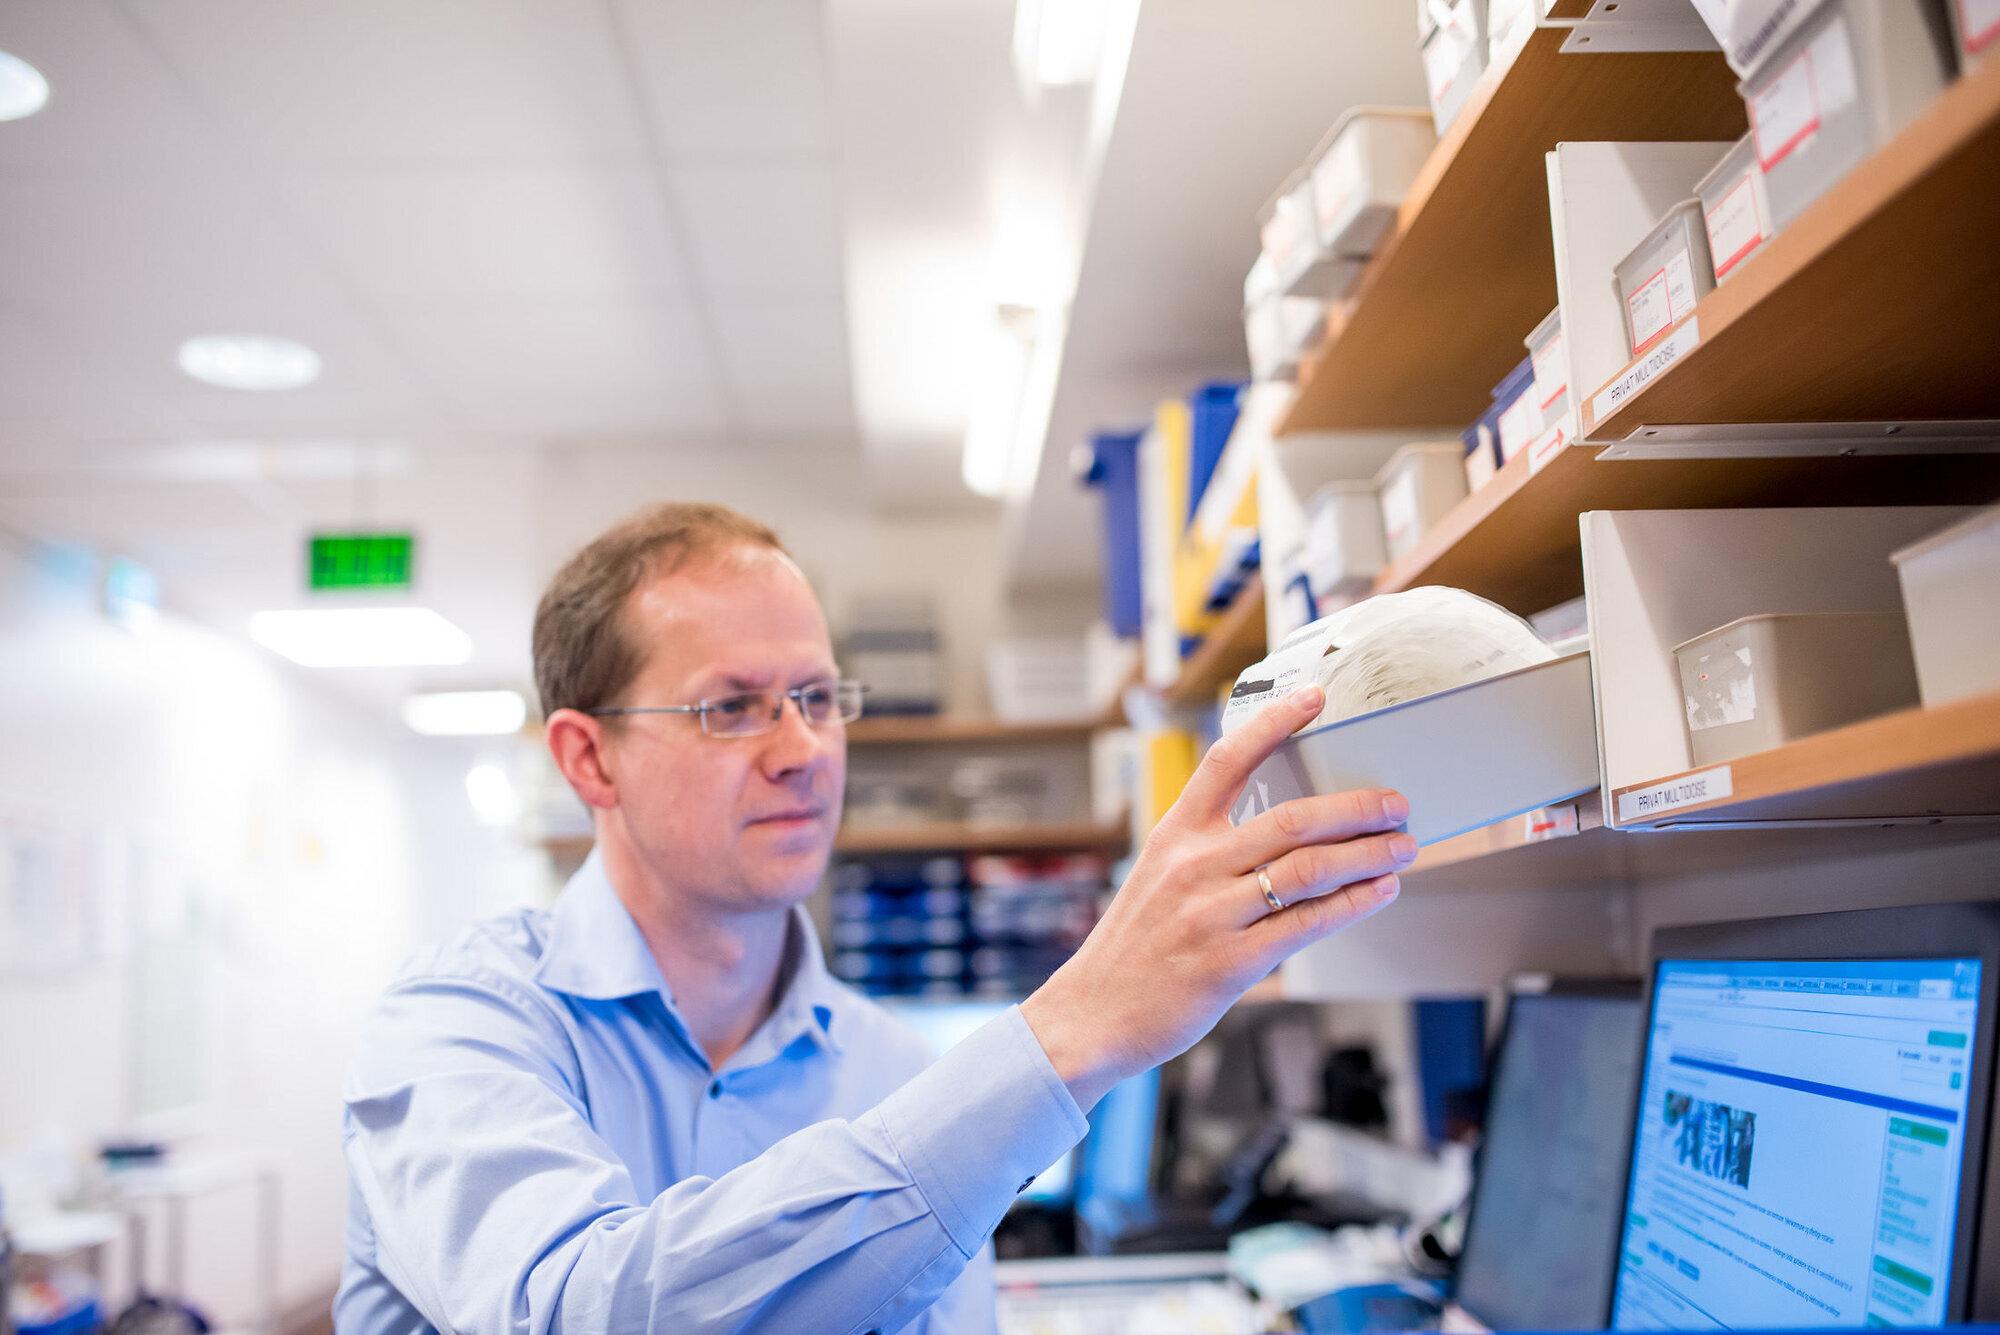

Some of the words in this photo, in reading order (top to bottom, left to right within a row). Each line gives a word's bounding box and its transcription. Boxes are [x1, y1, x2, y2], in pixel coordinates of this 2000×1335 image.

[1611, 374, 1634, 404] PRIVAT
[1635, 342, 1675, 384] MULTIDOSE
[1638, 791, 1663, 811] PRIVAT
[1664, 780, 1707, 804] MULTIDOSE
